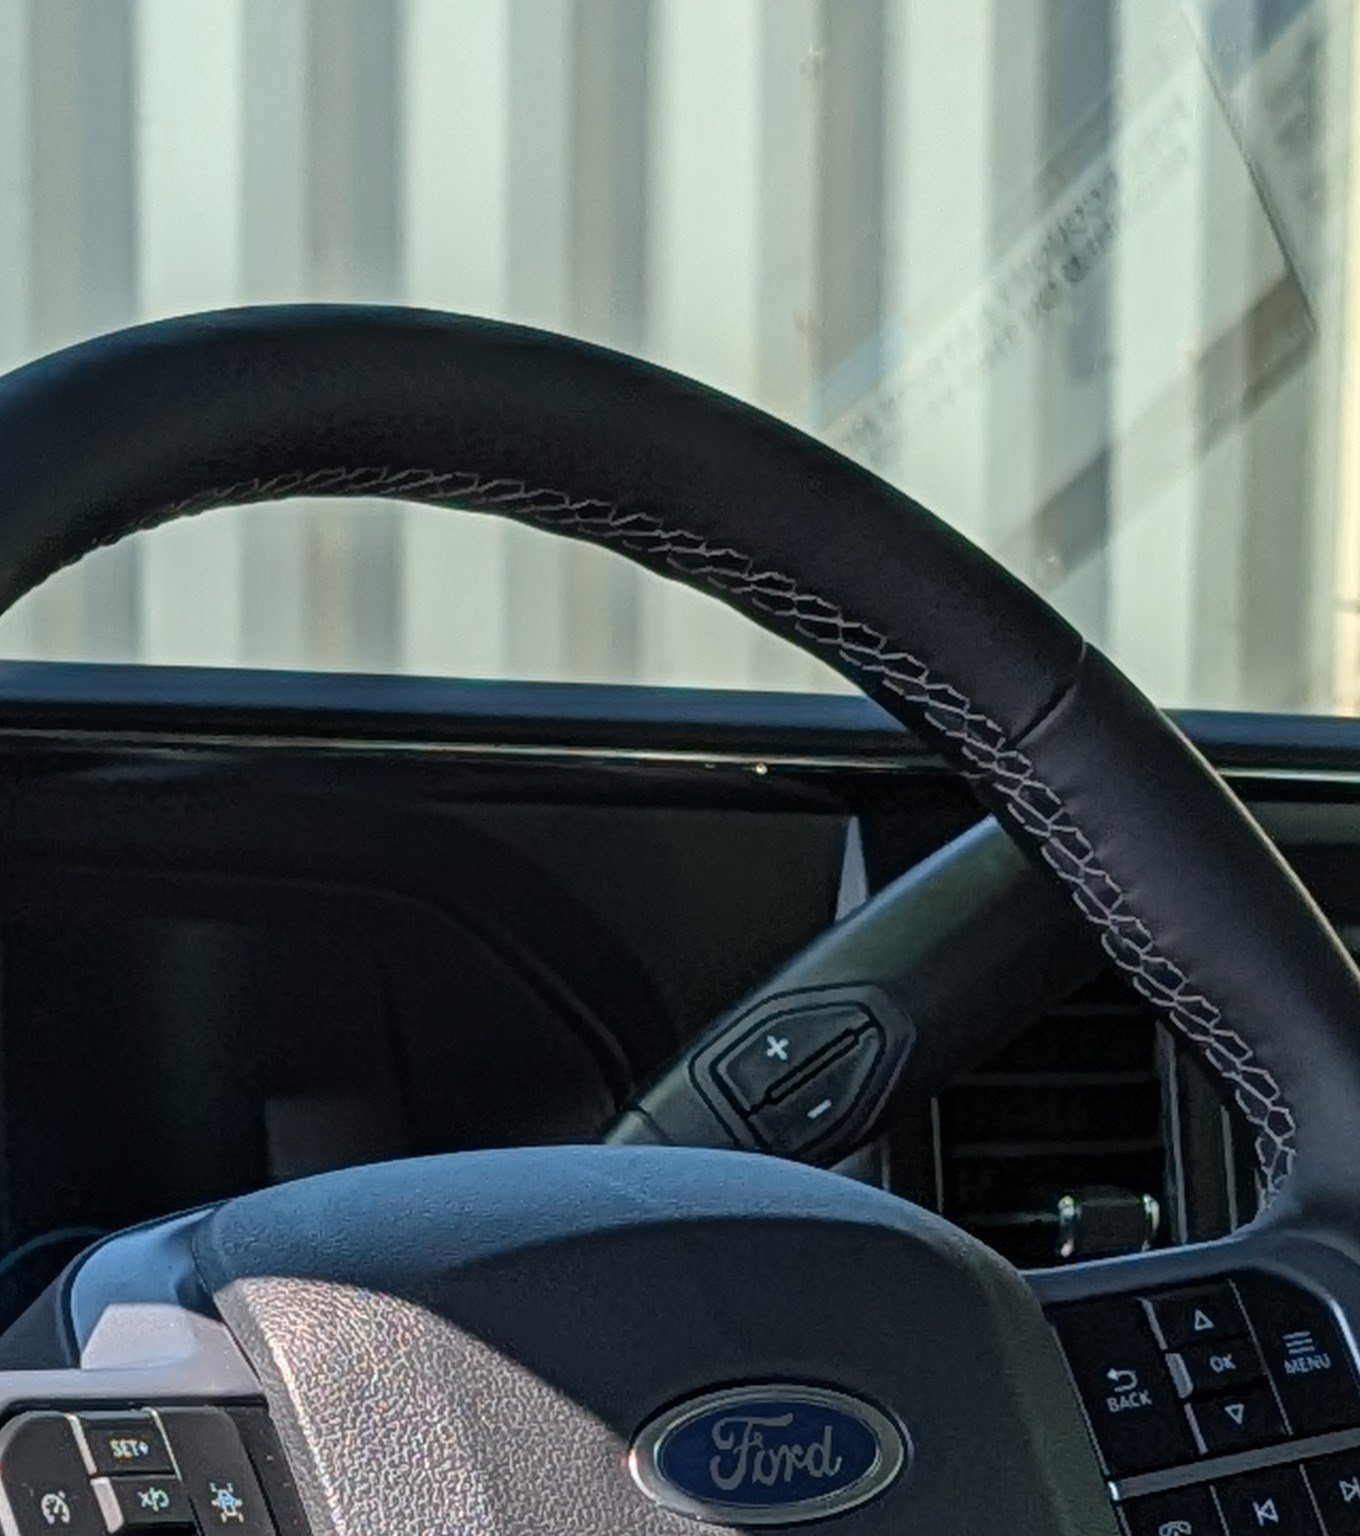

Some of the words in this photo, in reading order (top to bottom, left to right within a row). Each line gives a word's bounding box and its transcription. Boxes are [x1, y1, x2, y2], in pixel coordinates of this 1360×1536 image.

[1209, 1353, 1237, 1373] OK
[1284, 1354, 1332, 1376] MENU
[1106, 1389, 1152, 1413] BACK
[709, 1412, 843, 1491] Ford
